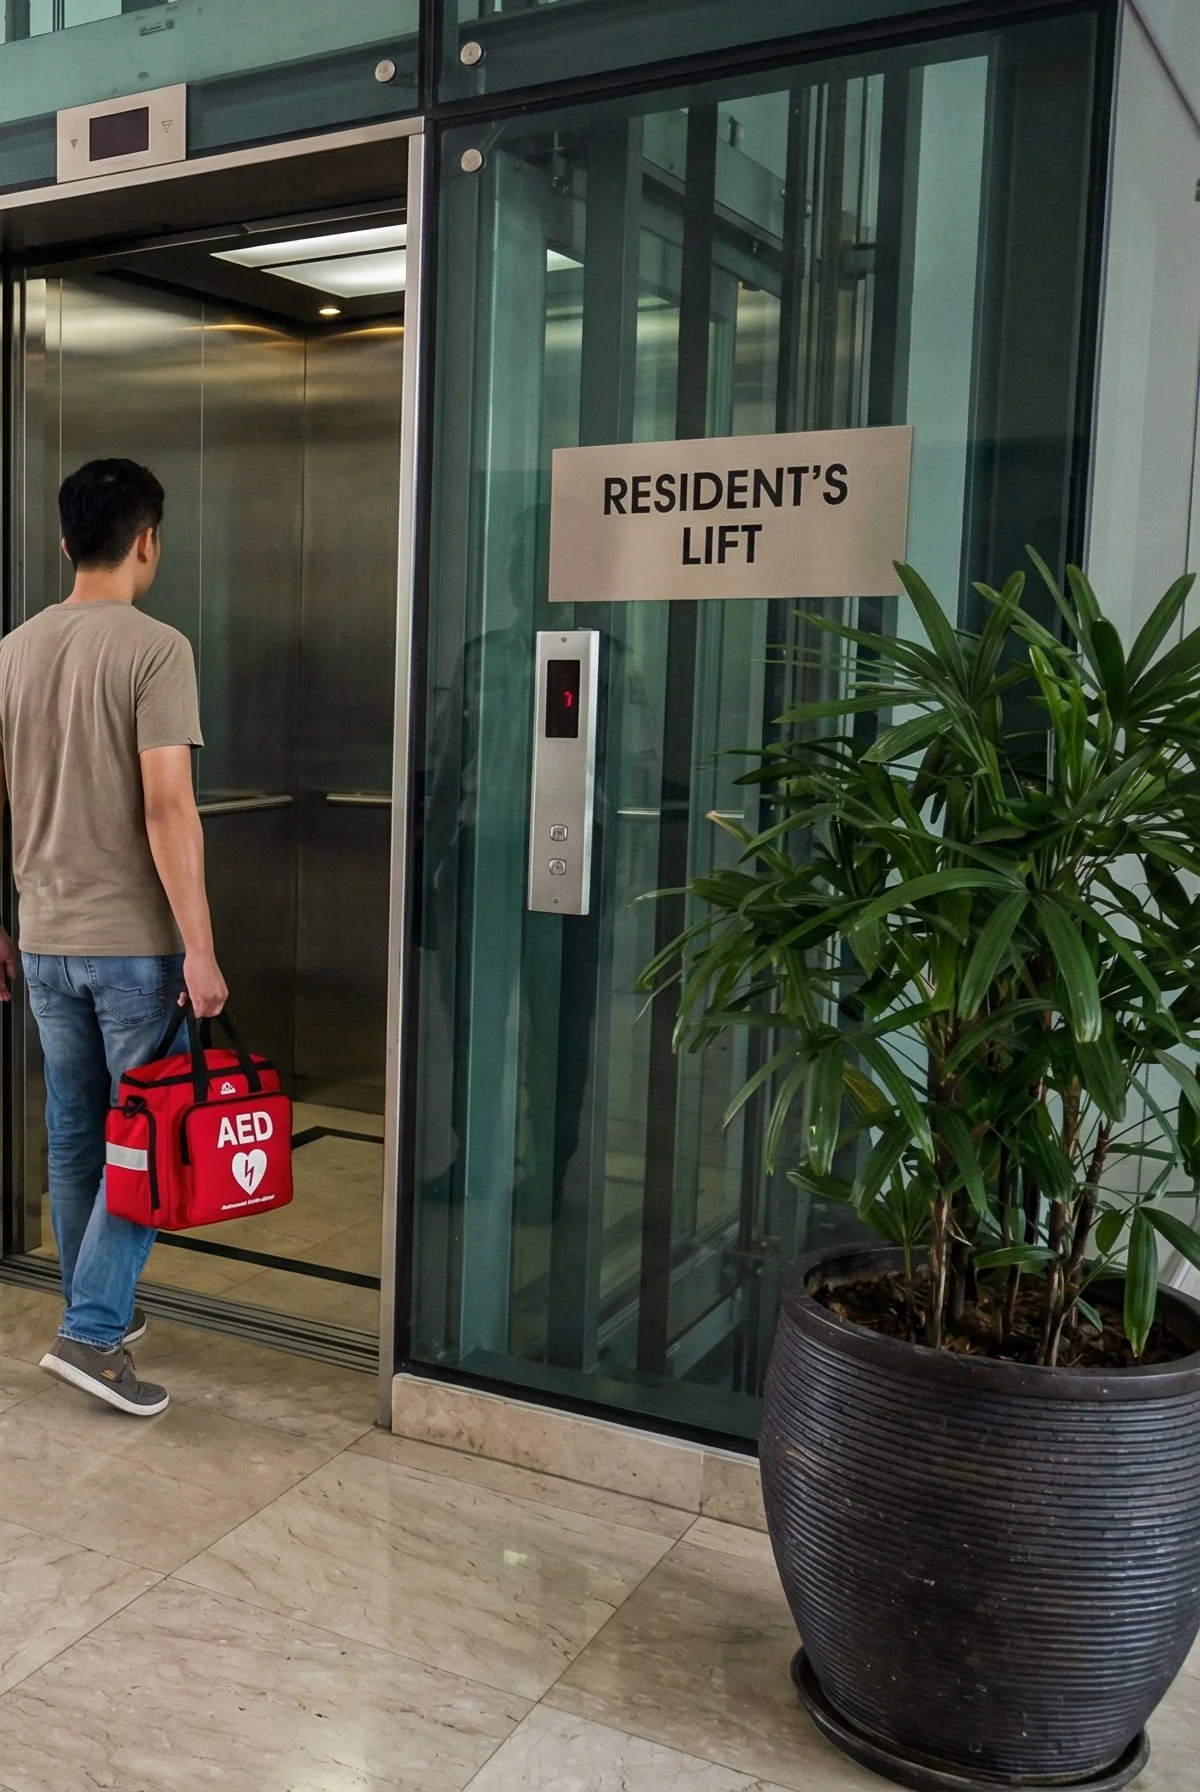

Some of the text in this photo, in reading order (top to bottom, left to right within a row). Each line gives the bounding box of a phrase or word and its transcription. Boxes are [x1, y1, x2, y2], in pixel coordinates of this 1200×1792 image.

[603, 463, 848, 515] RESIDENT'S
[682, 523, 763, 566] LIFT
[217, 1111, 274, 1149] AED
